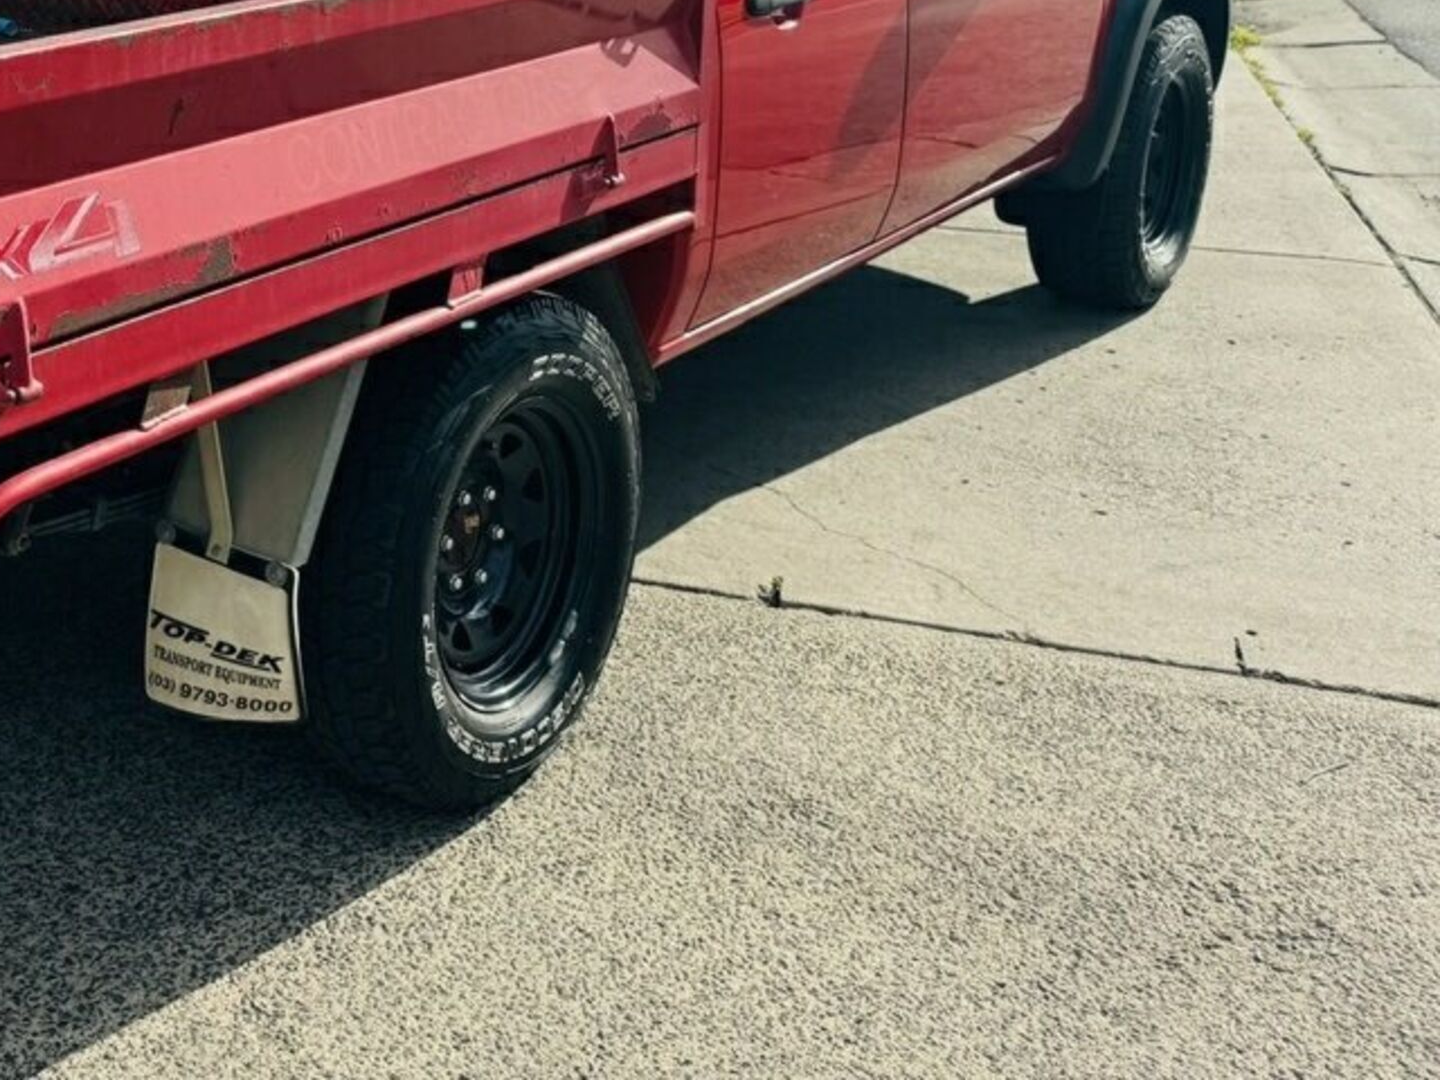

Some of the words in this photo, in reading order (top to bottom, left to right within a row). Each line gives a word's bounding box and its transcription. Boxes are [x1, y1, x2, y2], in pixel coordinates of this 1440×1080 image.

[150, 609, 285, 673] TOP-DEK
[149, 671, 176, 693] (03)
[154, 644, 212, 678] TRANSPORT
[215, 665, 283, 690] EQUIPMENT
